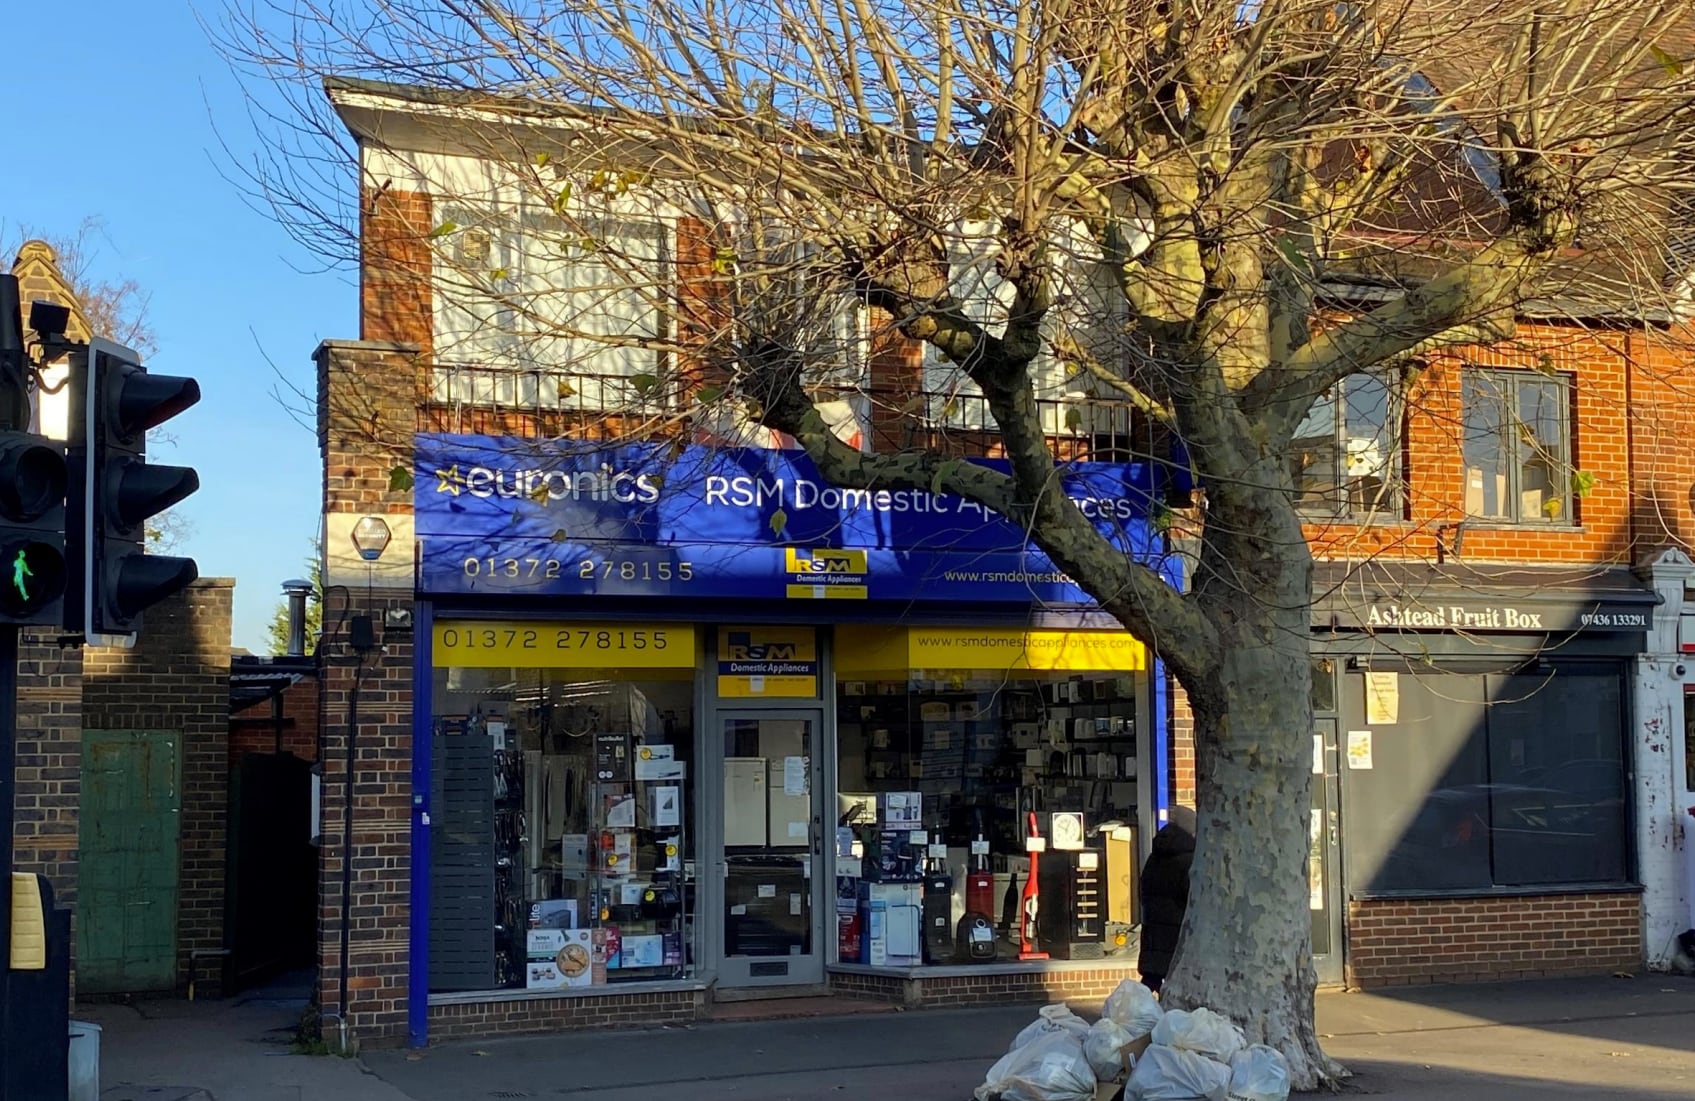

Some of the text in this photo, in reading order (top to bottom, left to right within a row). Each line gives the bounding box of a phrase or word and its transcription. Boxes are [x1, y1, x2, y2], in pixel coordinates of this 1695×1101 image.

[466, 462, 659, 503] euronics
[706, 475, 1132, 523] RSM Domestic Apces
[464, 557, 693, 581] 01372 278155
[796, 558, 851, 573] RSM
[796, 574, 862, 584] Domestic Appliances
[1367, 604, 1542, 628] Ashtead Fruit Box
[1581, 613, 1647, 626] 07436 133291
[443, 629, 667, 650] 01372 278155
[728, 643, 797, 660] RSM
[730, 662, 809, 674] Domestic Appliances
